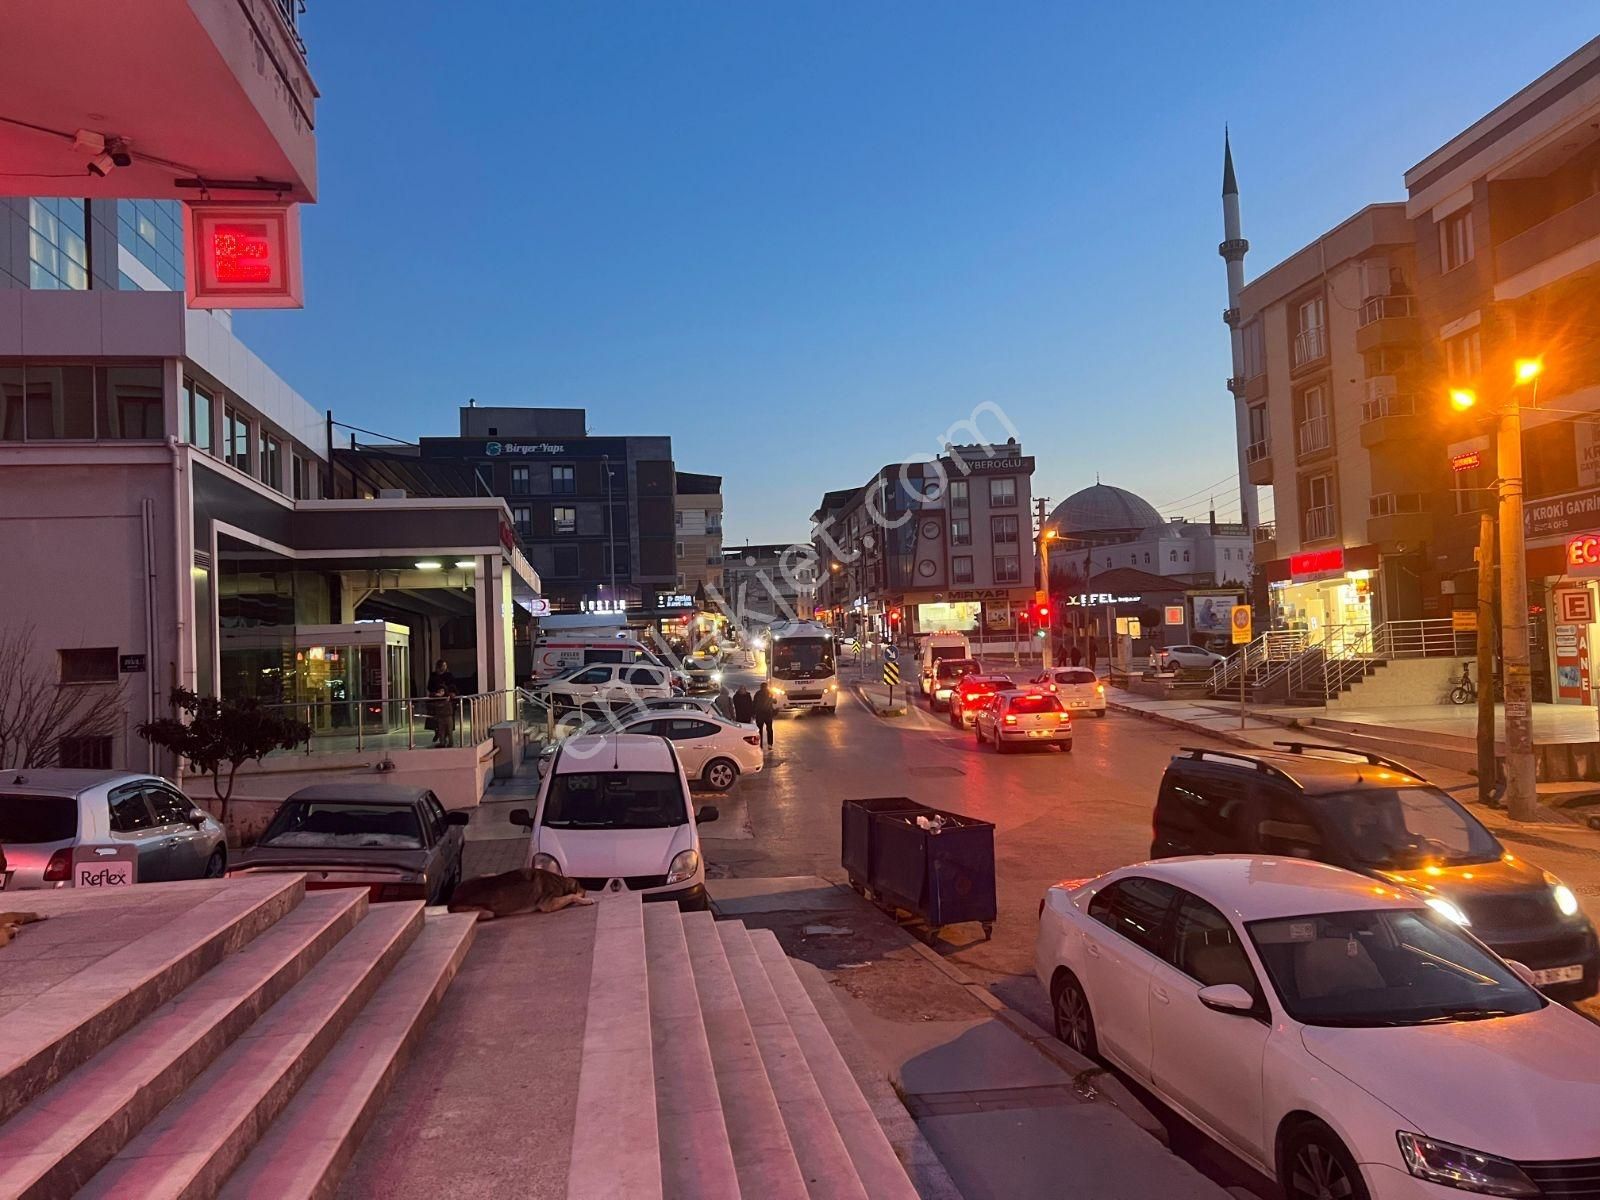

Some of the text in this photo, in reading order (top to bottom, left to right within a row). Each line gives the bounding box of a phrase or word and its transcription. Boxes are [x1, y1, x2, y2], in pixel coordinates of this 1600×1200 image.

[215, 224, 271, 283] E
[1533, 502, 1564, 520] KROKİ
[1569, 597, 1587, 617] E
[81, 868, 126, 887] Reflex
